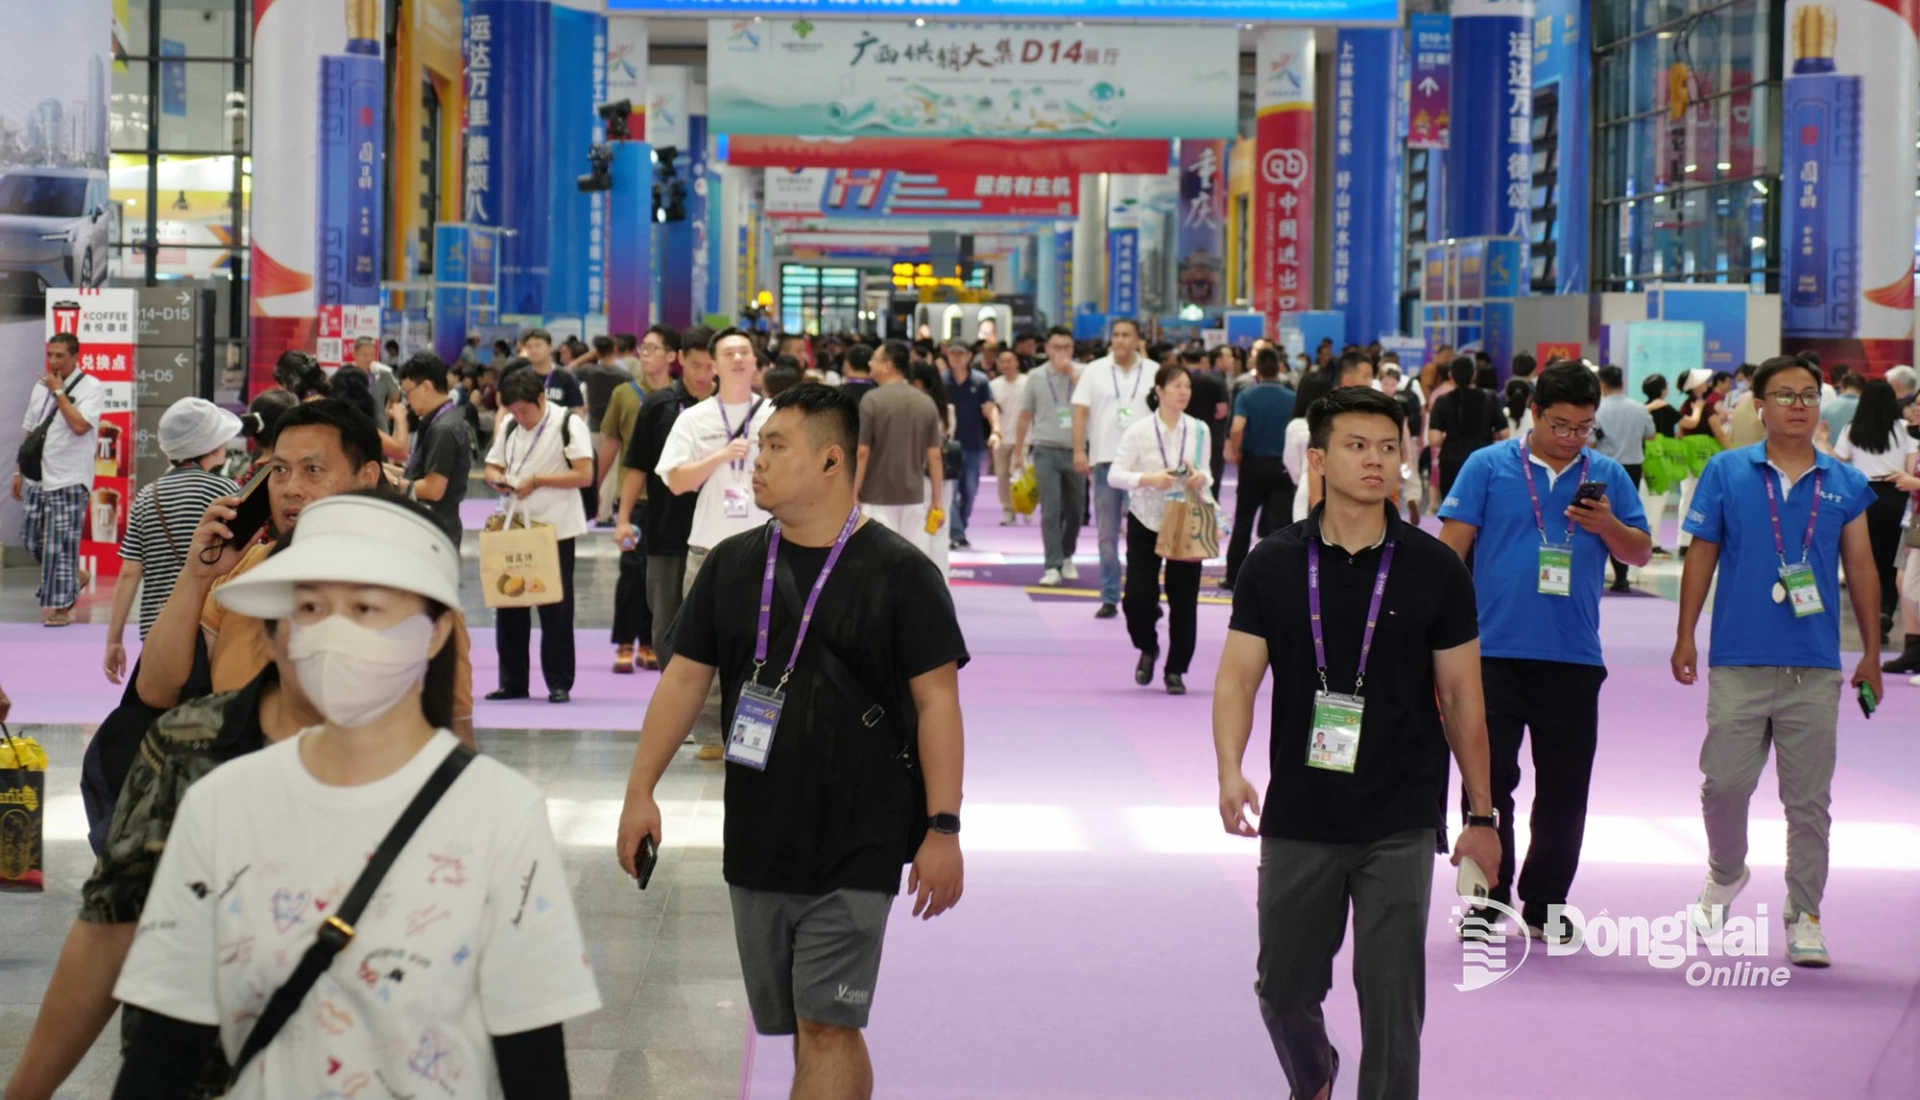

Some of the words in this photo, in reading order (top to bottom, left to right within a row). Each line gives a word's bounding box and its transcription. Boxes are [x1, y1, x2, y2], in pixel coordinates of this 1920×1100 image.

[848, 30, 1016, 71] 广西供销大集
[469, 15, 491, 127] 运达万里
[1507, 31, 1532, 145] 运达万里
[1184, 148, 1218, 229] 重庆
[83, 311, 128, 321] KCOFFEE
[83, 322, 128, 332] 肯悦咖啡
[82, 354, 126, 371] 兑换点
[137, 369, 173, 382] 4~D5
[137, 429, 157, 442] 6~
